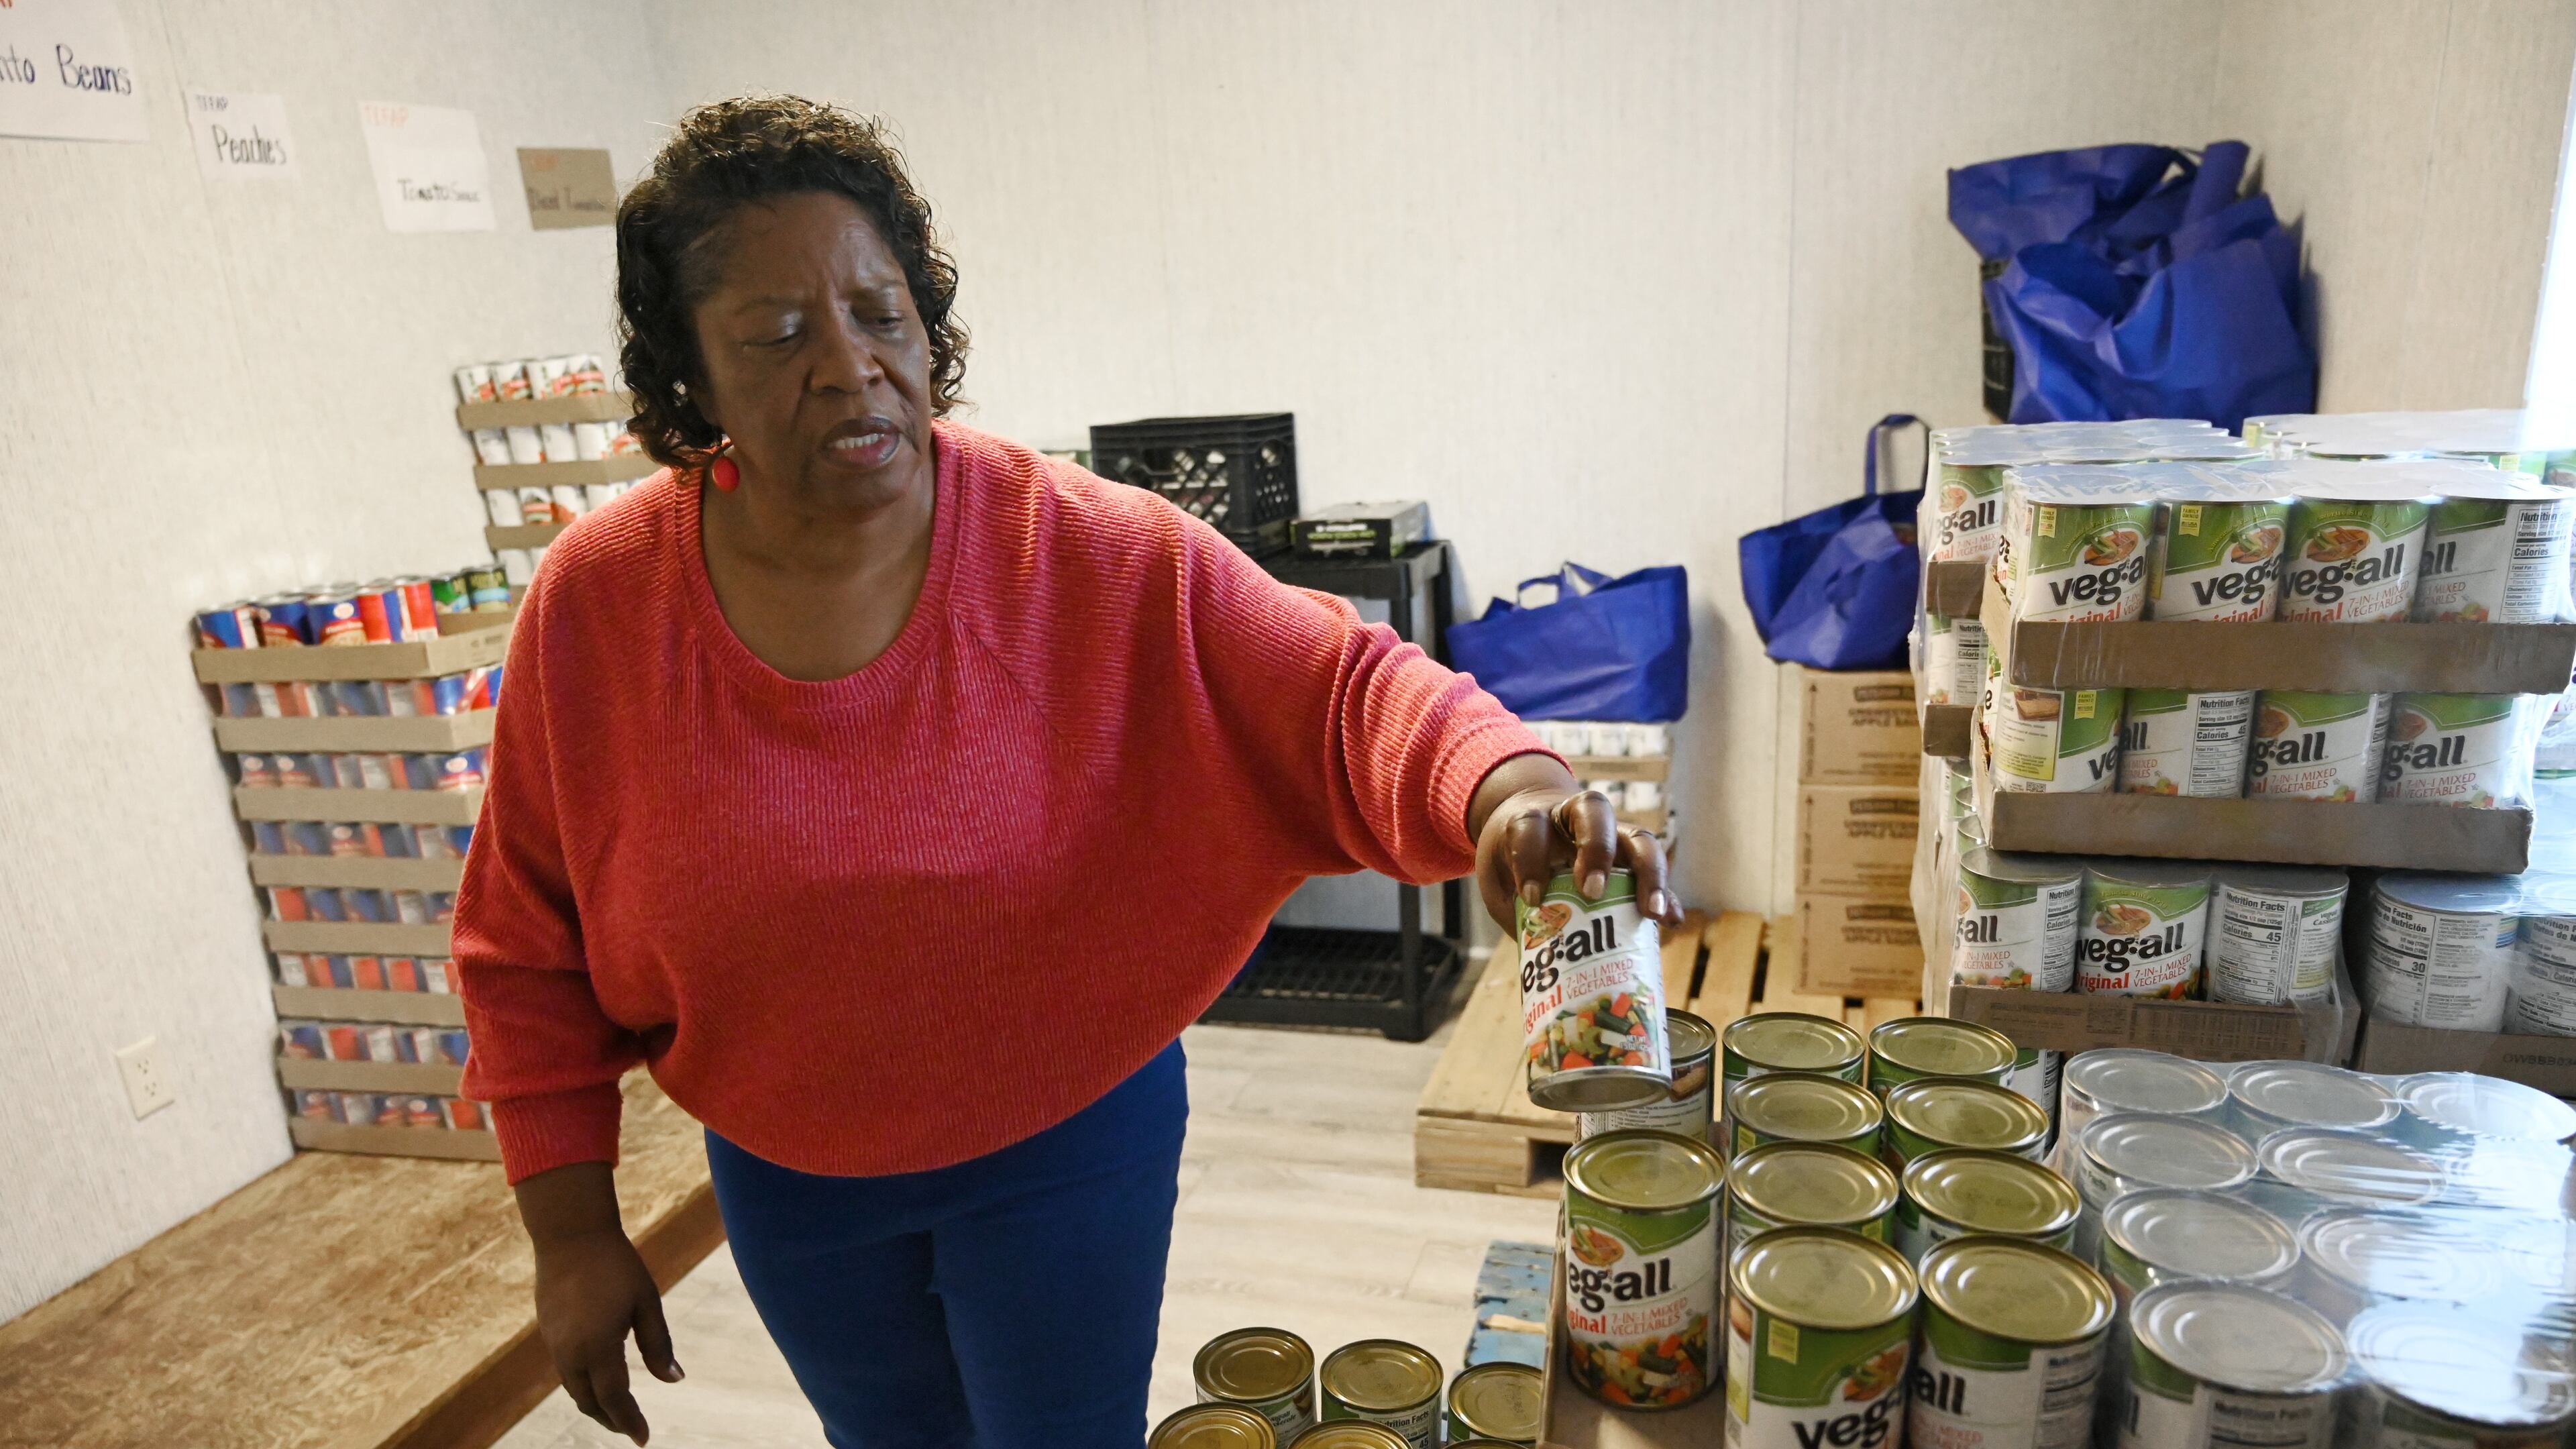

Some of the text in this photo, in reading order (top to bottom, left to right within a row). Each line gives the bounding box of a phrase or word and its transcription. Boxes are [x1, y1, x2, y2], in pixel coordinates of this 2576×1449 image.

[55, 43, 131, 96] Beans
[212, 123, 287, 165] Peaches
[2514, 547, 2549, 557] Calories
[2350, 580, 2409, 608] 7-IN-1 MIXED
[2434, 582, 2466, 594] MIXED
[2347, 594, 2404, 619] VEGETABLES
[2200, 699, 2235, 708] Nutrition
[2197, 731, 2229, 739] Calories
[2272, 768, 2337, 783] 7-IN-1 MIXED
[2407, 772, 2476, 788] 7-IN-1 MIXED
[2404, 784, 2467, 799] VEGETABLES
[2049, 887, 2074, 900] Nutrition
[2227, 892, 2258, 908] Nutrition
[2260, 900, 2286, 912] Facts
[2393, 908, 2414, 920] Facts
[2047, 918, 2071, 929] Calories
[2392, 916, 2427, 933] Nutrición
[2222, 923, 2282, 943] Calories 45
[2557, 931, 2568, 941] de
[1982, 951, 2010, 961] MIXED
[1566, 958, 1633, 988] 7-IN-1 MIXED
[2135, 953, 2192, 979] 7-IN-1 MIXED
[2411, 961, 2426, 973] 30
[2134, 965, 2187, 987] VEGETABLES
[1566, 971, 1629, 1000] VEGETABLES
[1613, 1297, 1688, 1324] 7-IN-1 MIXED
[1611, 1313, 1681, 1336] VEGETABLES
[1411, 1410, 1430, 1424] Facts
